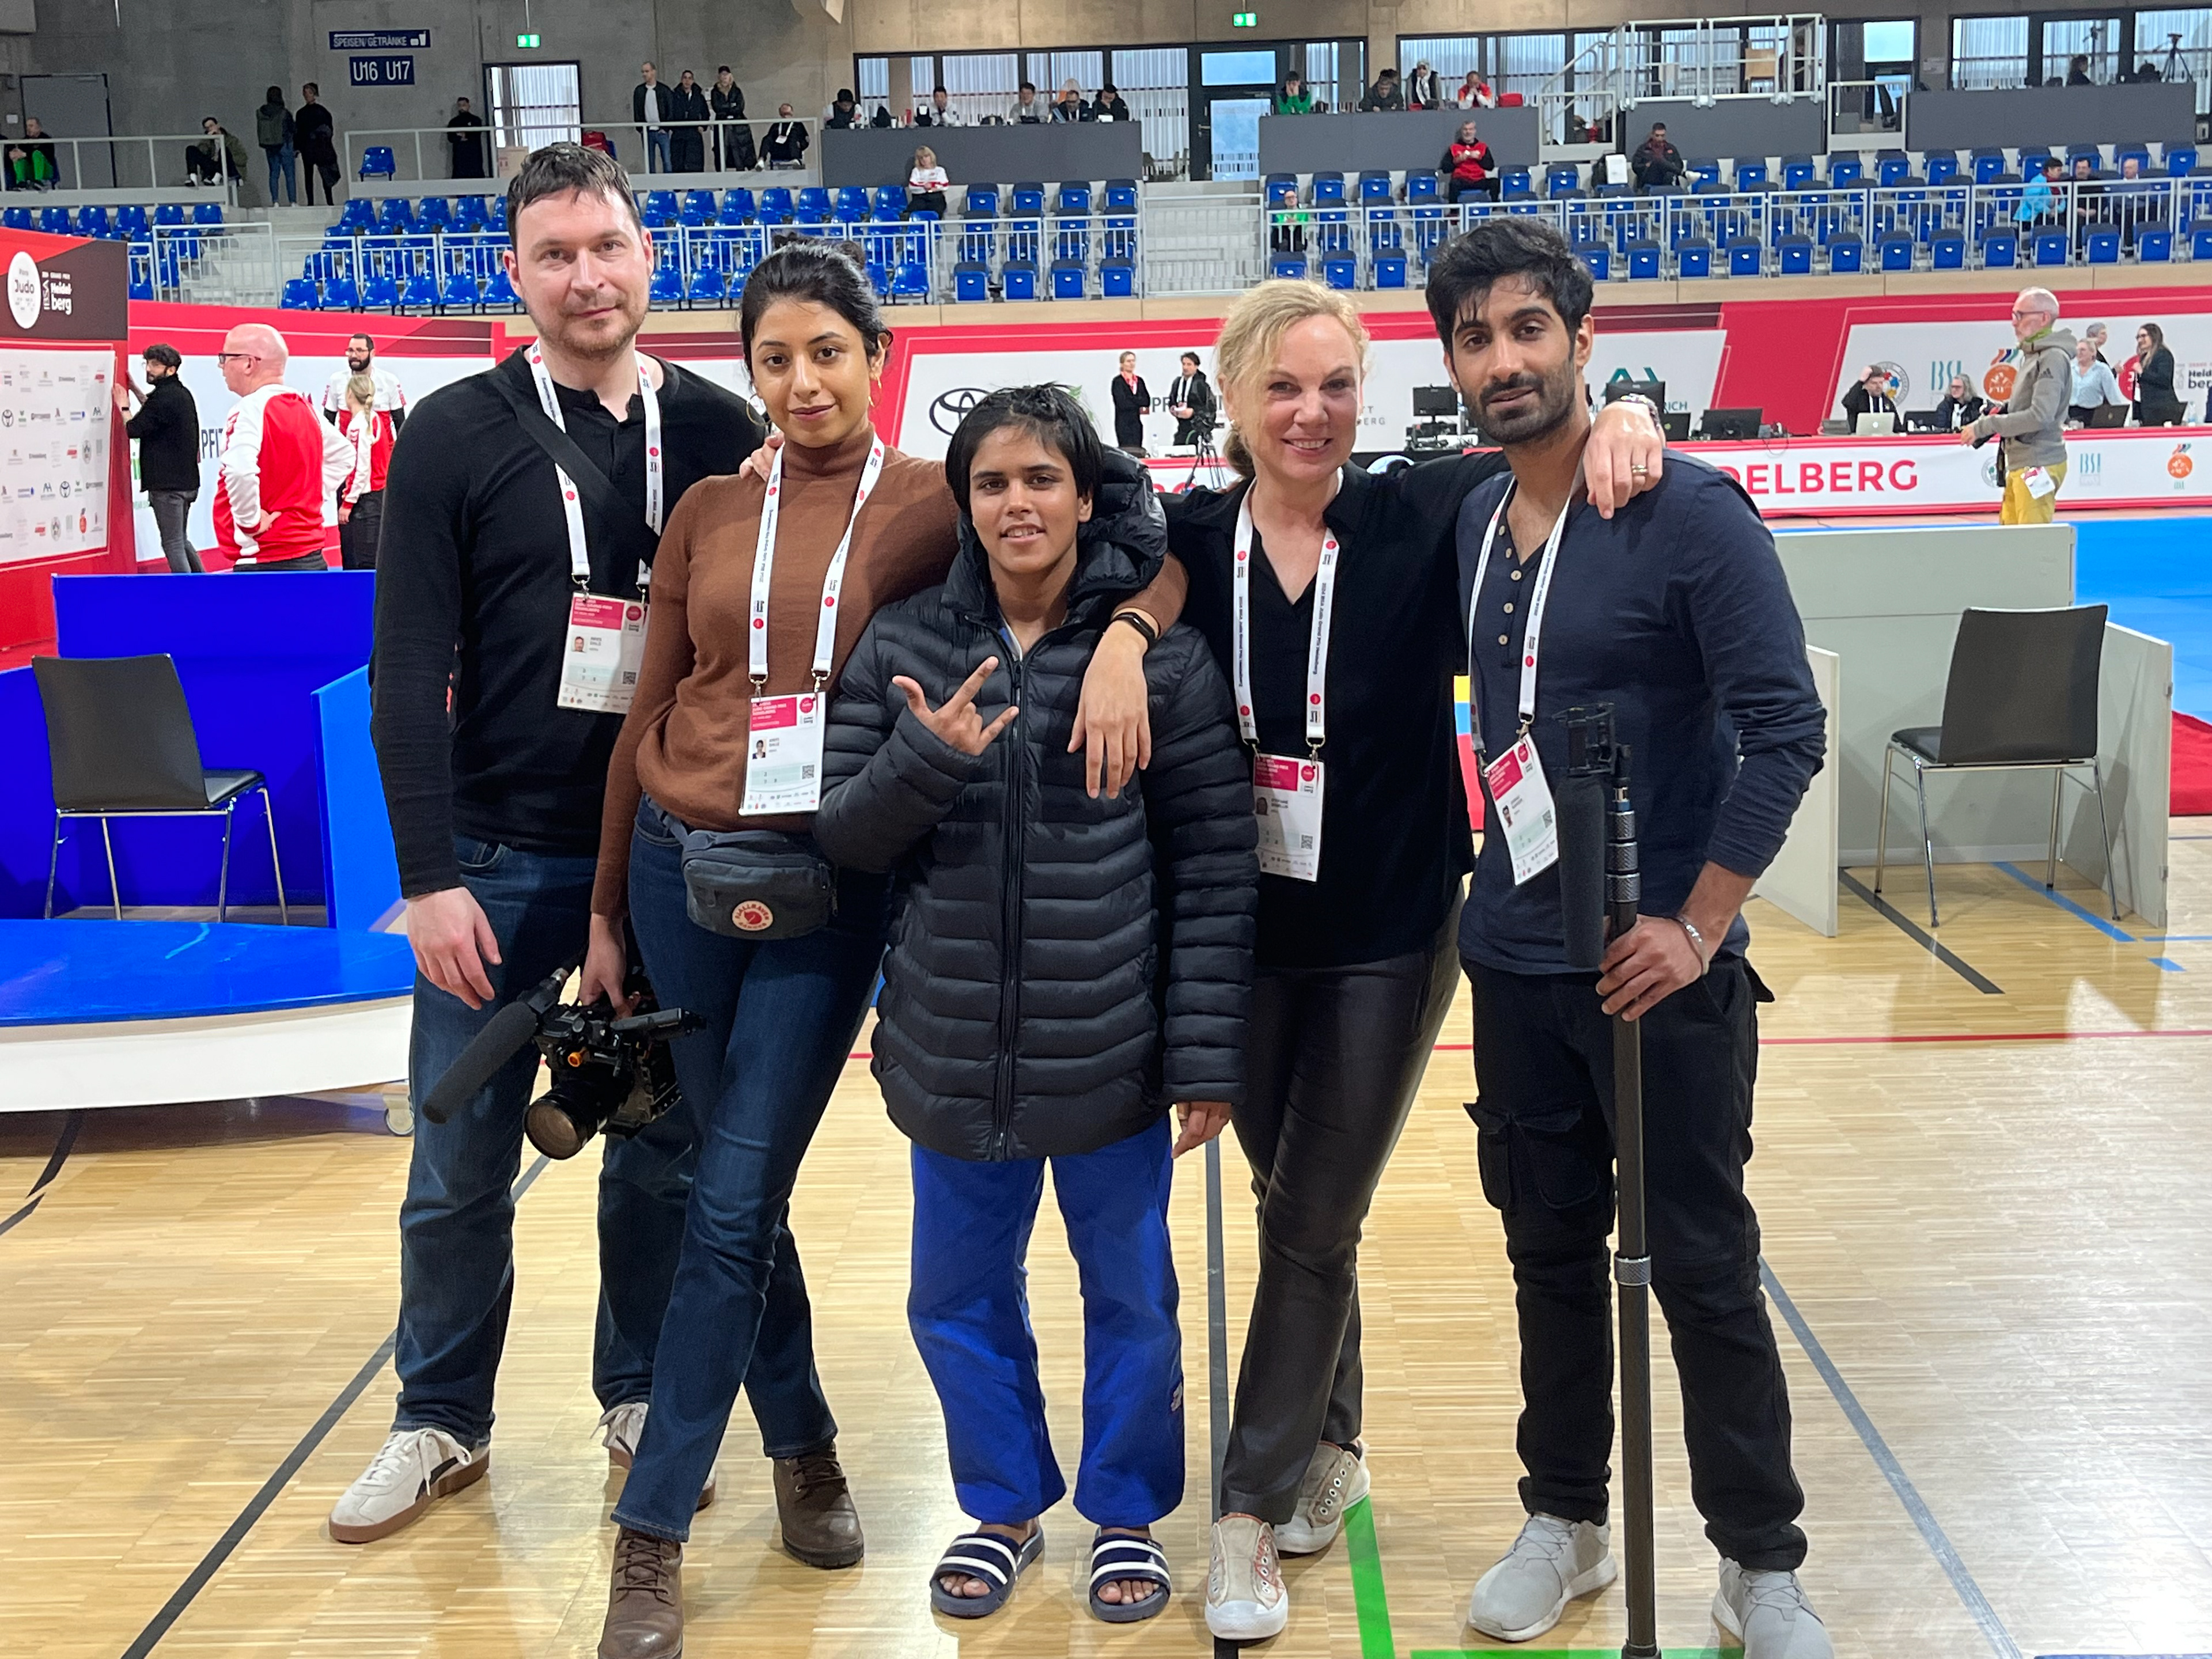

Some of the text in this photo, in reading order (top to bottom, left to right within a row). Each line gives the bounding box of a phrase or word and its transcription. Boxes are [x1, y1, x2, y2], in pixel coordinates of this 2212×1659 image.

[353, 61, 410, 81] U16 U17
[15, 279, 35, 294] Judo
[51, 294, 72, 315] berg
